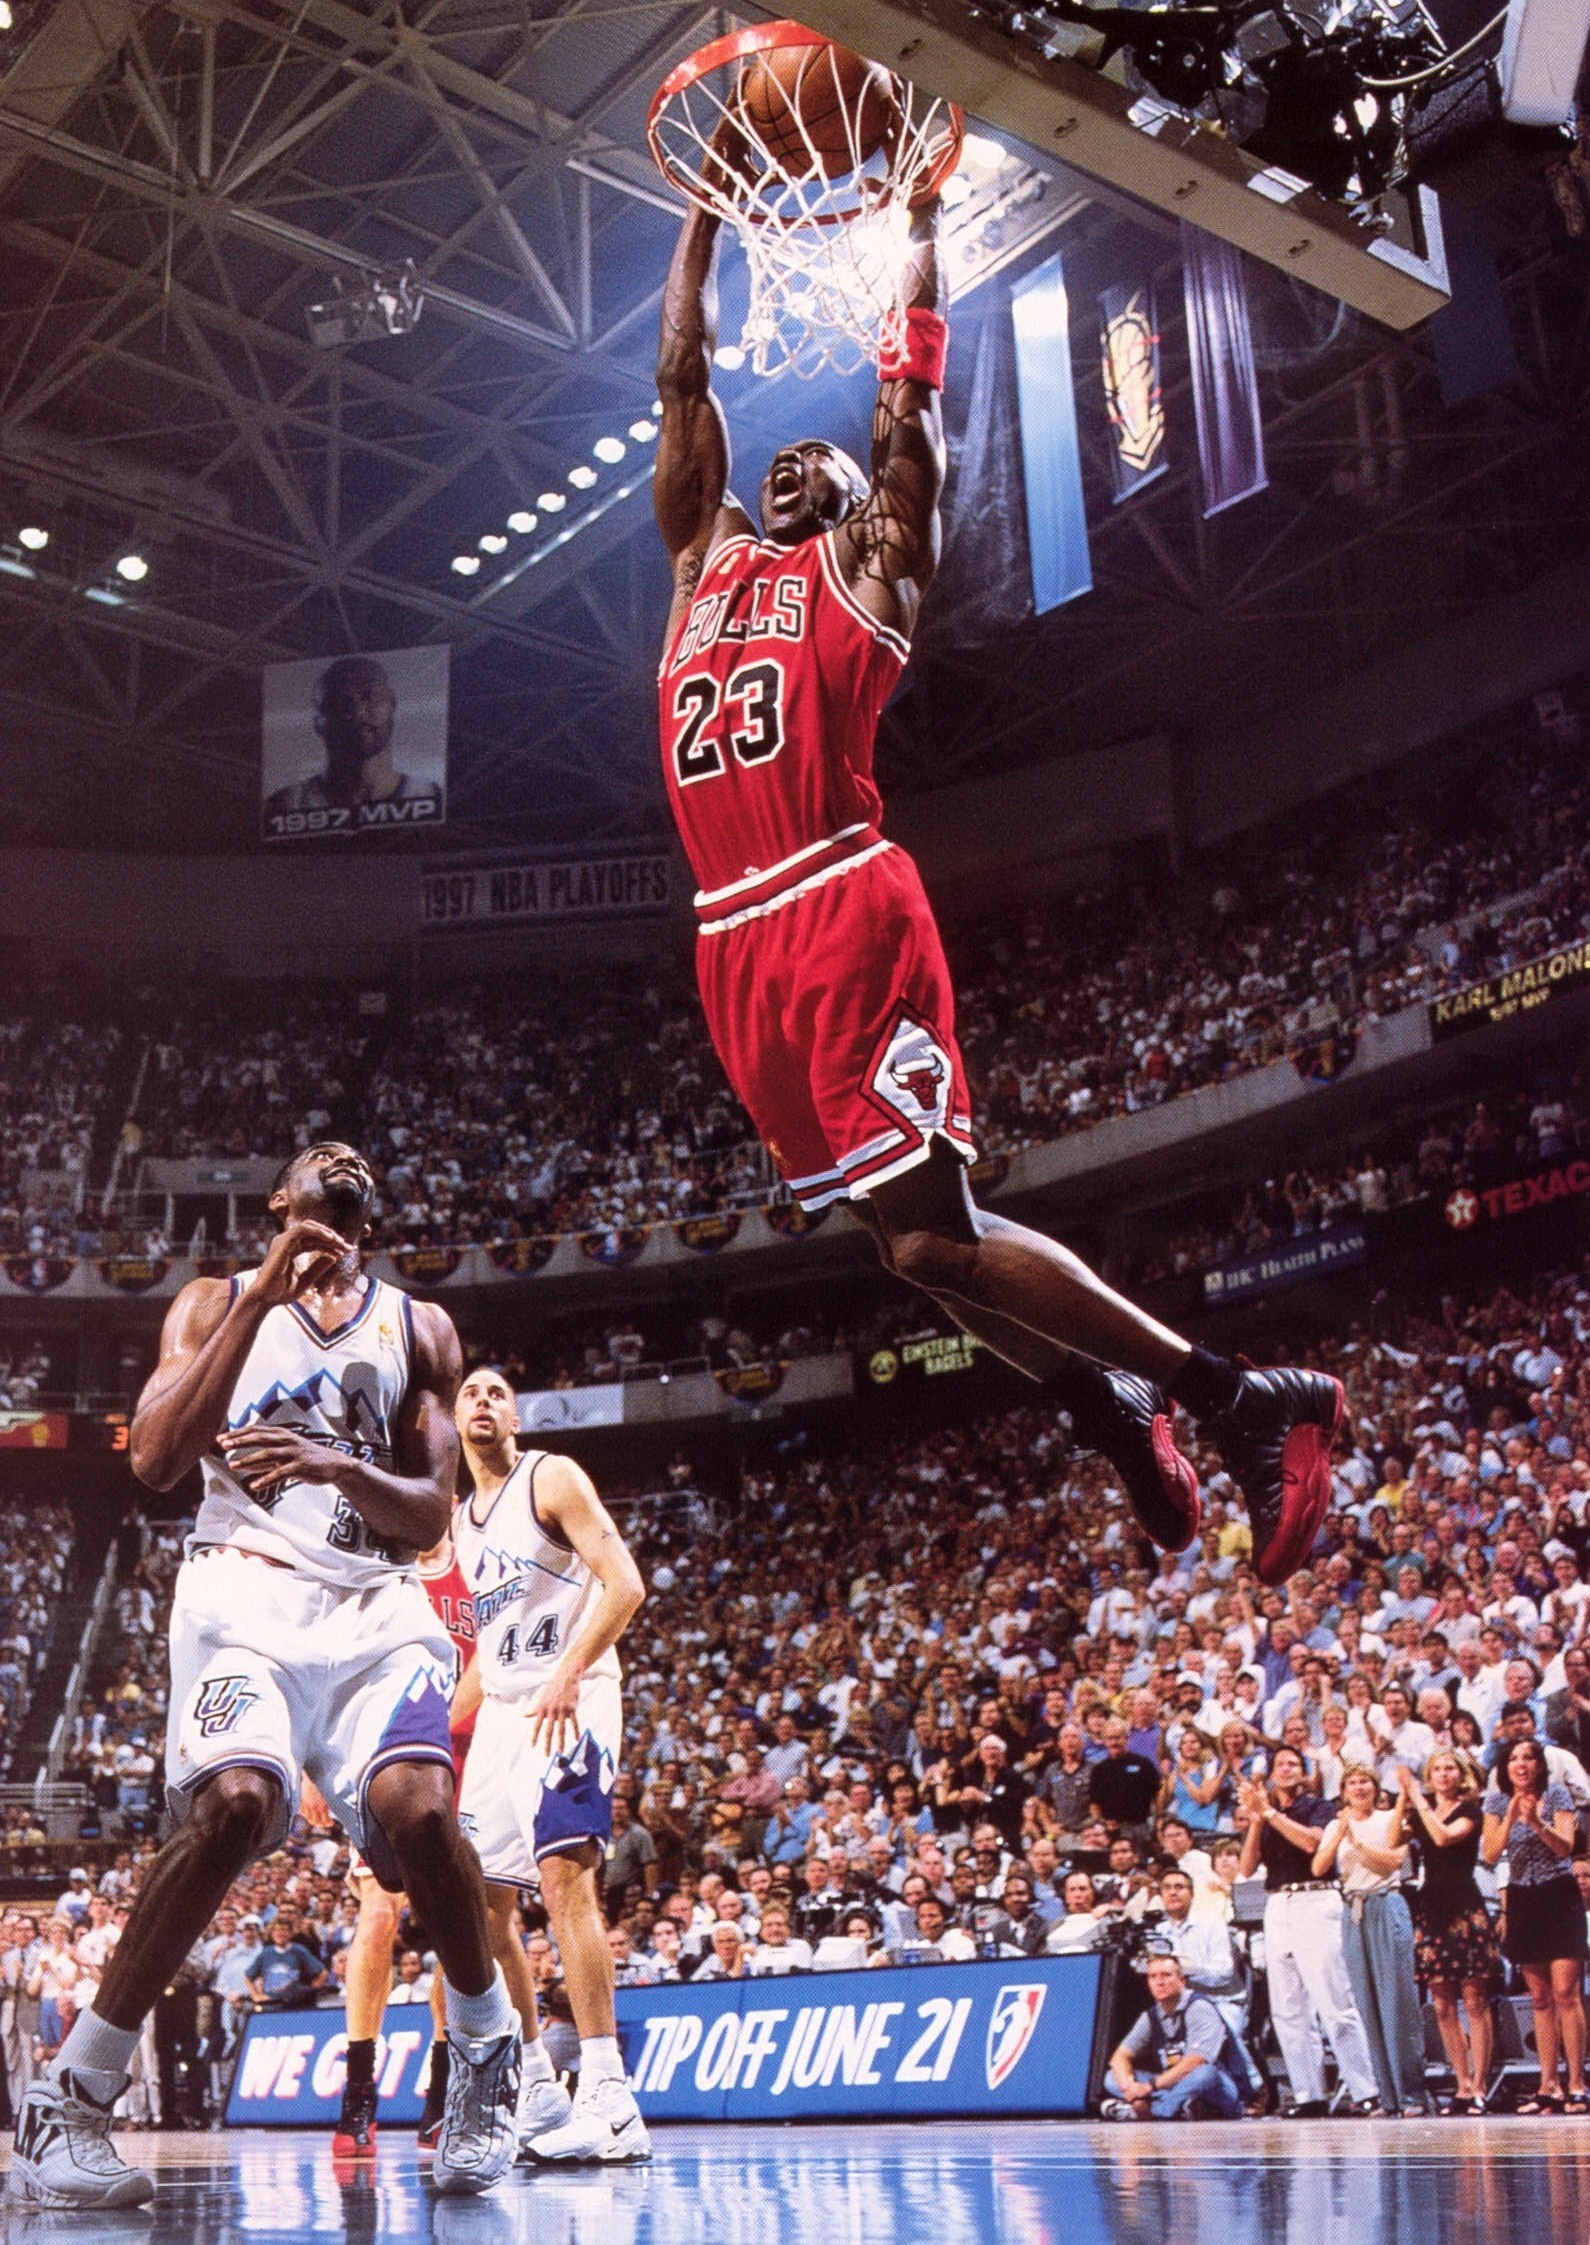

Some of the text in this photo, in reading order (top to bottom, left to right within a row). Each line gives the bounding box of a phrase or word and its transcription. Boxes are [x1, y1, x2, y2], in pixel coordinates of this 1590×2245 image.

[669, 574, 807, 679] BULLS
[672, 657, 786, 788] 23
[271, 799, 437, 834] 1997 MVP
[423, 858, 670, 921] 1997 NBA PLAYOFFS
[1435, 983, 1496, 1024] KARL
[496, 1613, 560, 1667] 44
[238, 2034, 316, 2100] WE
[630, 1997, 974, 2096] TIP OFF JUNE 21
